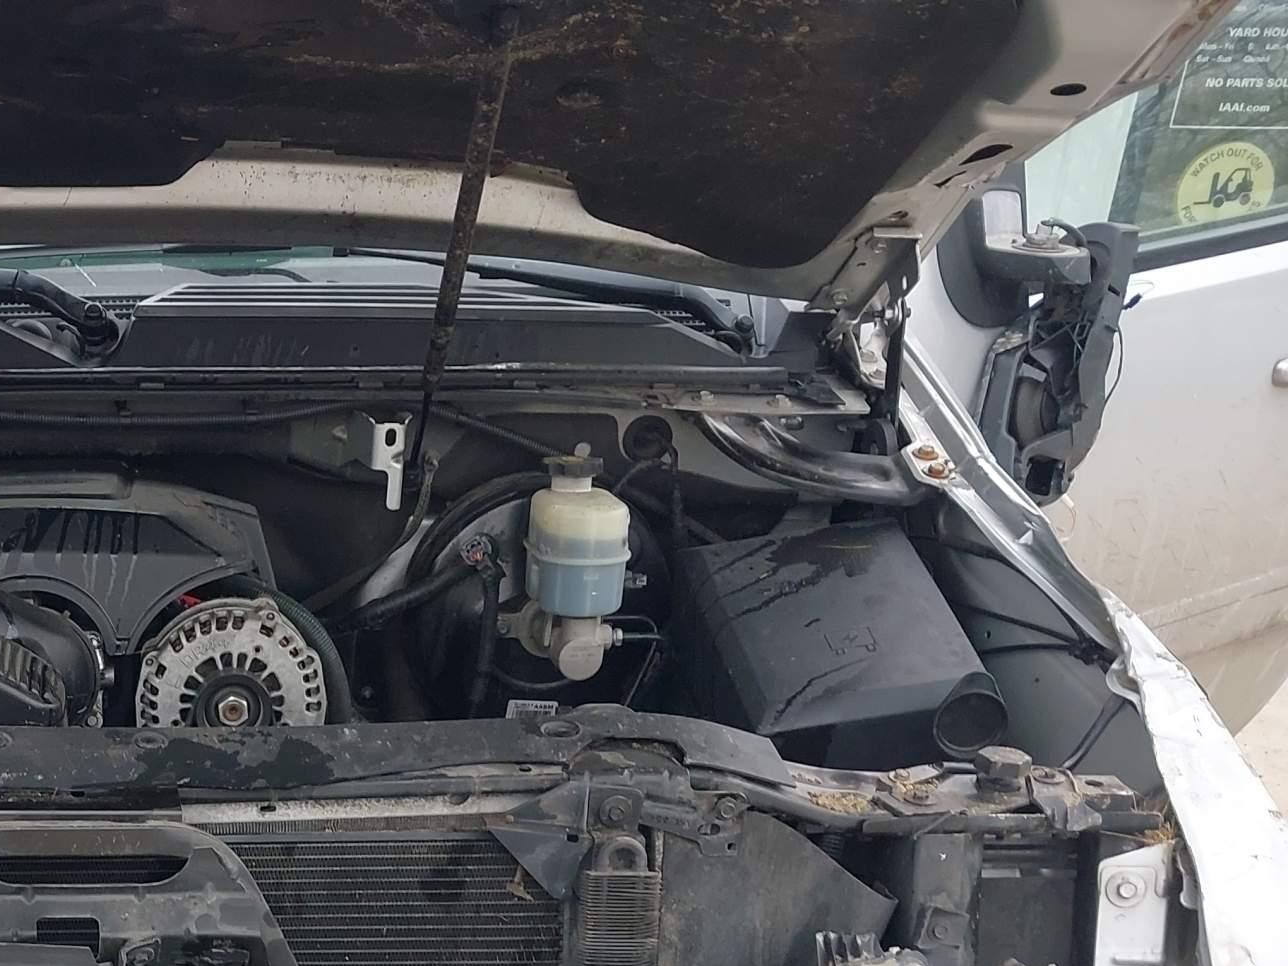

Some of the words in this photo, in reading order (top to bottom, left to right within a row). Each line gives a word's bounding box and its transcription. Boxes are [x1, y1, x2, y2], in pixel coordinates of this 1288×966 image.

[1227, 27, 1260, 37] YARD
[1205, 77, 1224, 88] NO
[1226, 77, 1264, 88] PARTS
[1218, 102, 1271, 112] IAAI.com
[1191, 150, 1225, 177] WATCH
[1226, 147, 1248, 158] OUT
[1246, 152, 1264, 171] FOR
